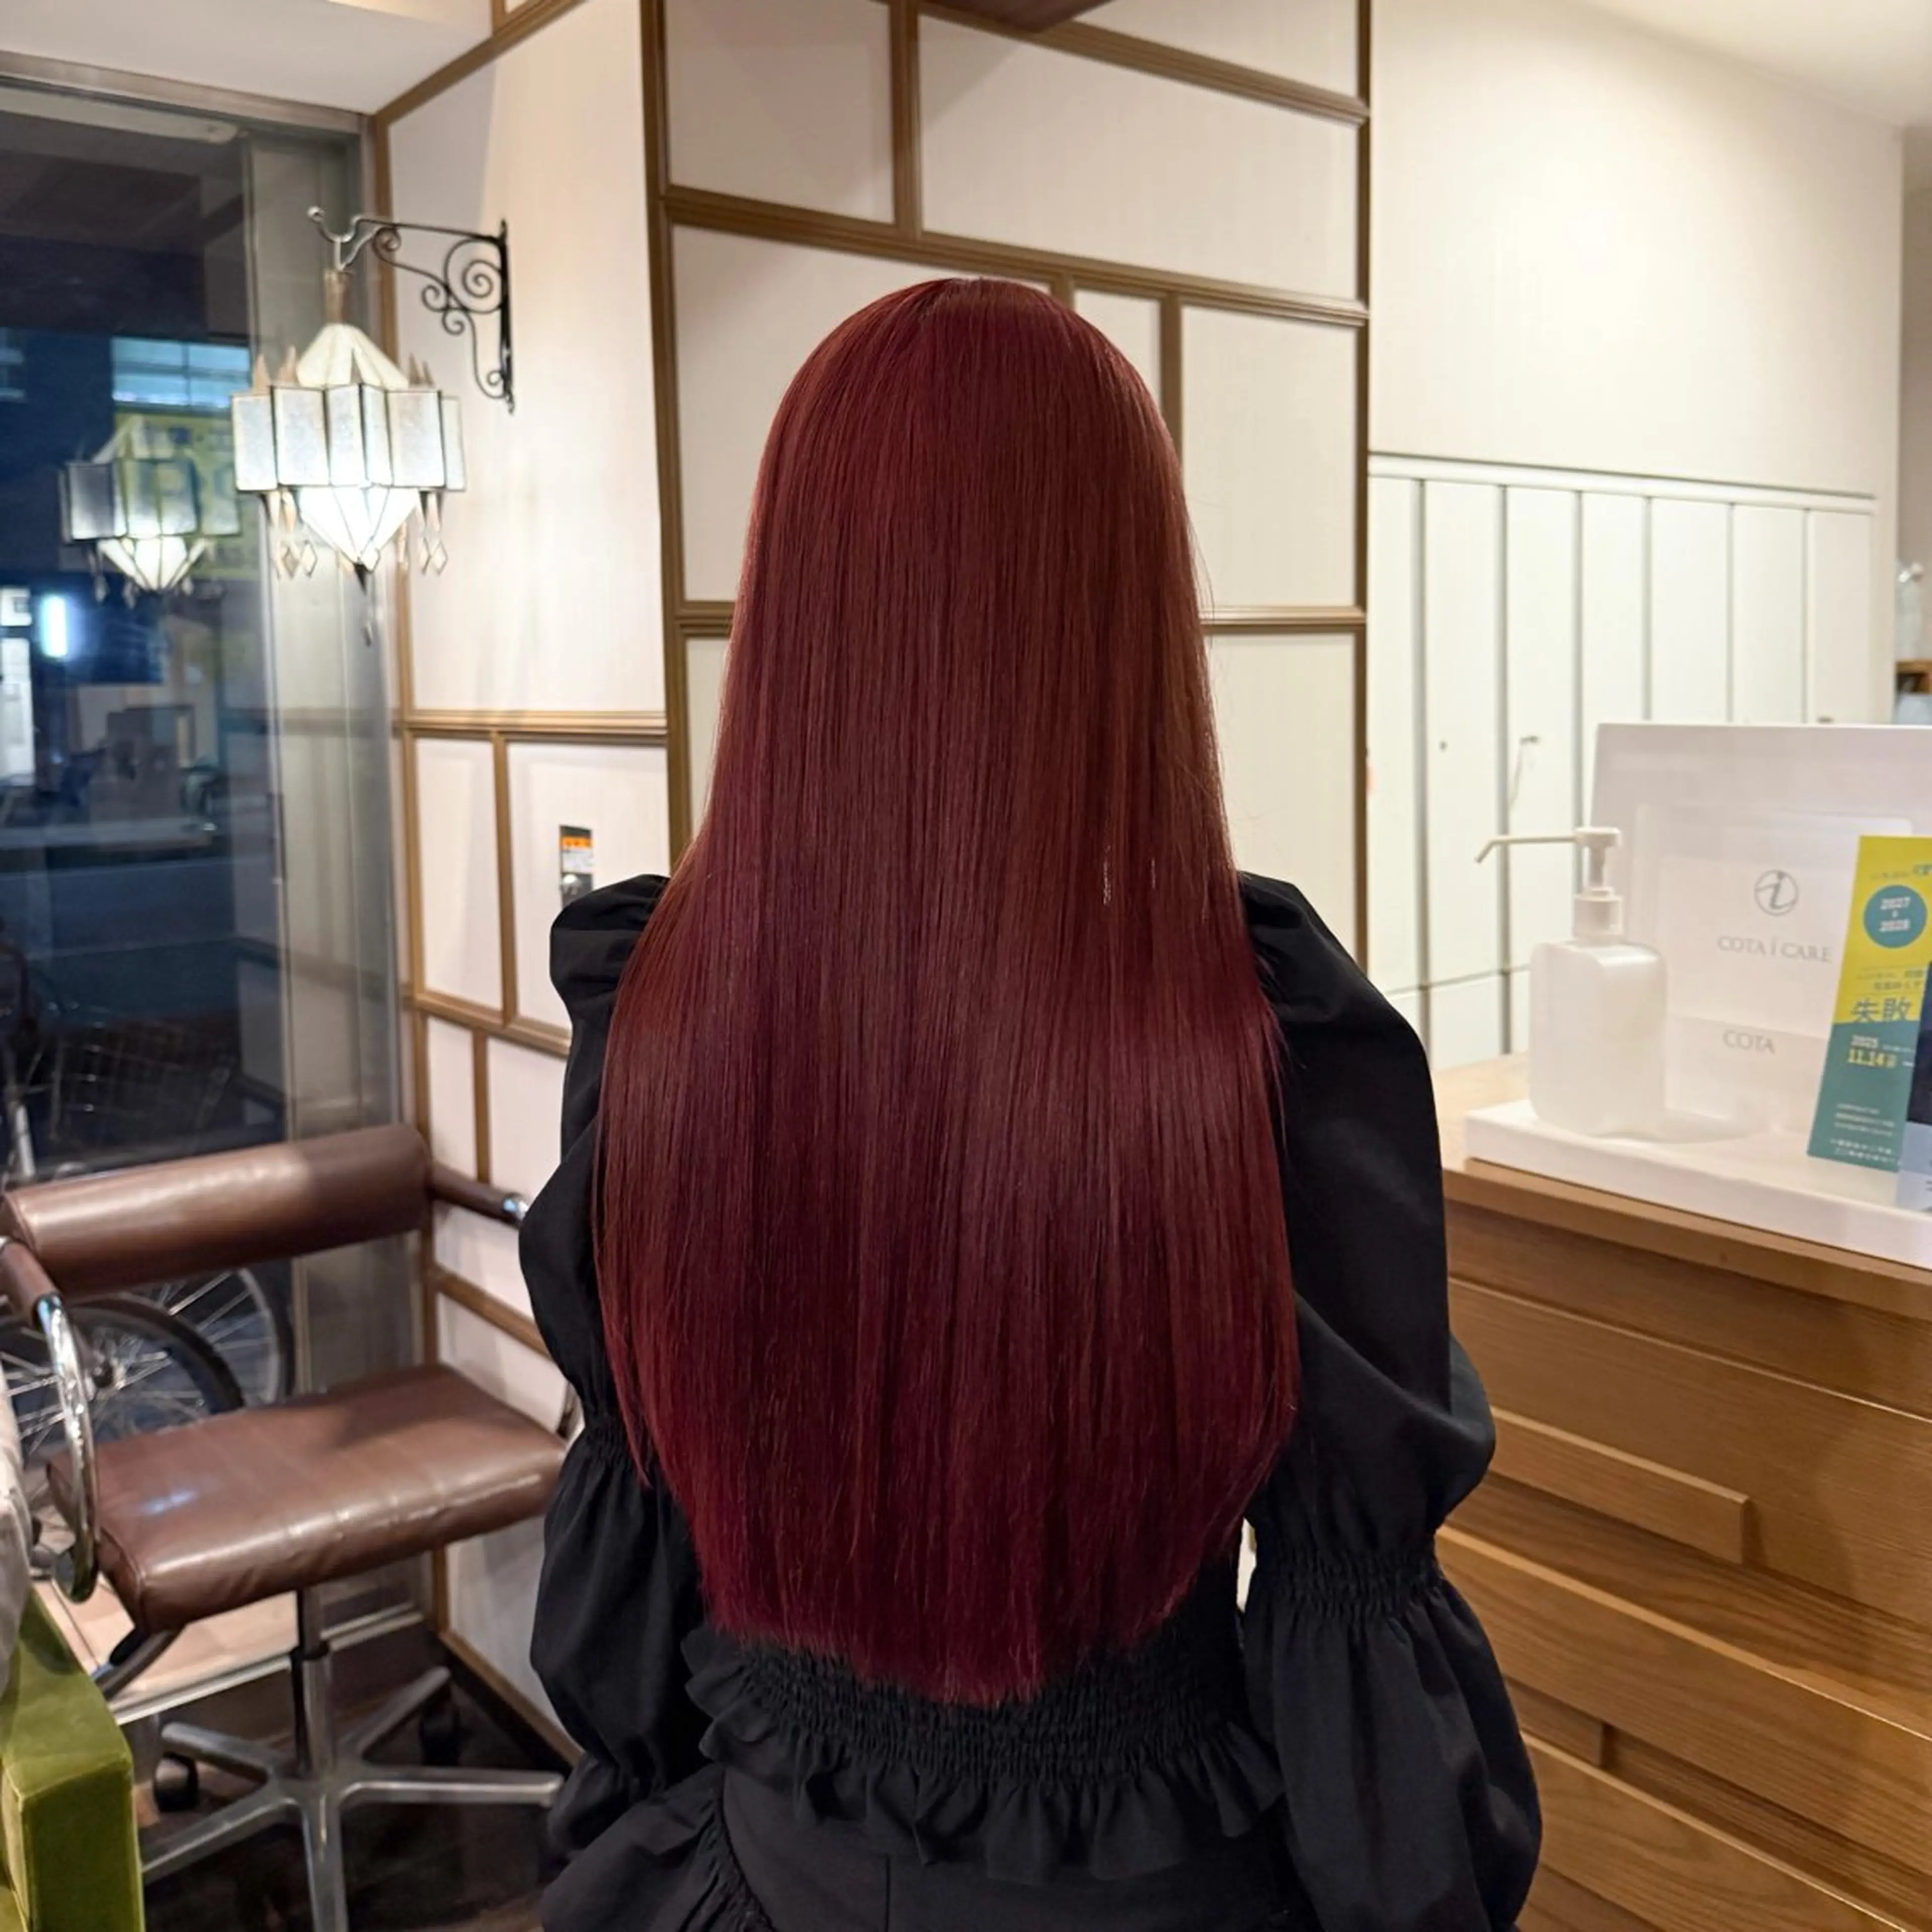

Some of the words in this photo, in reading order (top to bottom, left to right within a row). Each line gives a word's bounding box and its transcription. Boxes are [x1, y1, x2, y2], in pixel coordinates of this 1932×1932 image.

[1716, 936, 1766, 955] COTA
[1780, 941, 1833, 963] CARE
[1850, 994, 1914, 1023] 失敗
[1722, 1028, 1776, 1055] COTA
